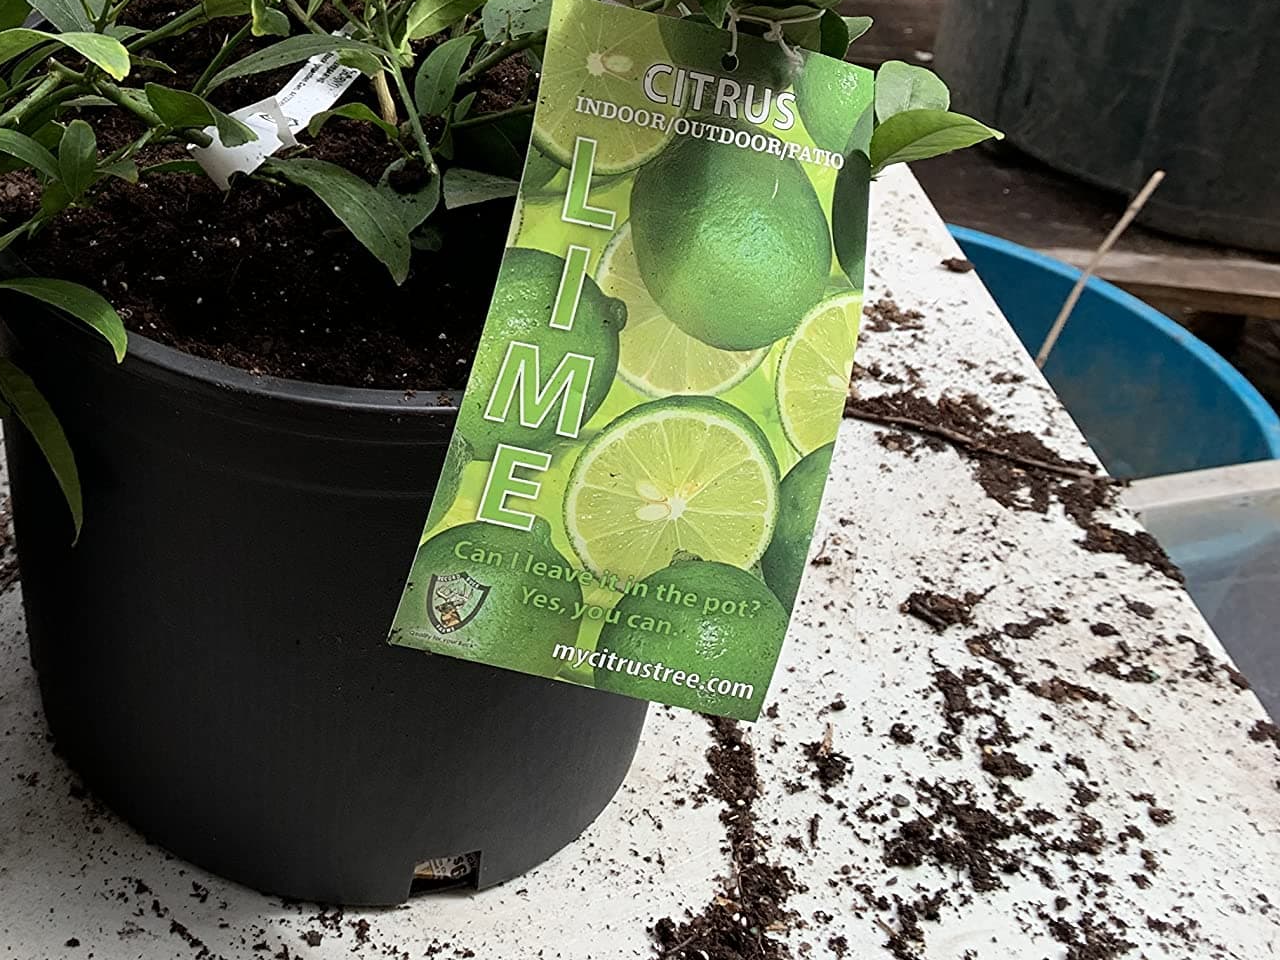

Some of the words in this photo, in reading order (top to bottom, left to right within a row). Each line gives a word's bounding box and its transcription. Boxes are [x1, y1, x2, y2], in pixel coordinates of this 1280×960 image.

[643, 64, 796, 130] CITRUS
[575, 96, 845, 170] INDOOR/OUTDOOR/PATIO
[474, 136, 616, 531] LIME
[454, 540, 503, 567] Can
[510, 551, 518, 569] I
[523, 553, 593, 586] leave
[599, 570, 619, 592] it
[624, 576, 648, 598] in
[656, 584, 698, 608] the
[701, 595, 762, 620] pot?
[520, 586, 566, 616] Yes,
[570, 601, 620, 626] you
[627, 612, 678, 637] can.
[552, 643, 755, 700] mycitrustree.com
